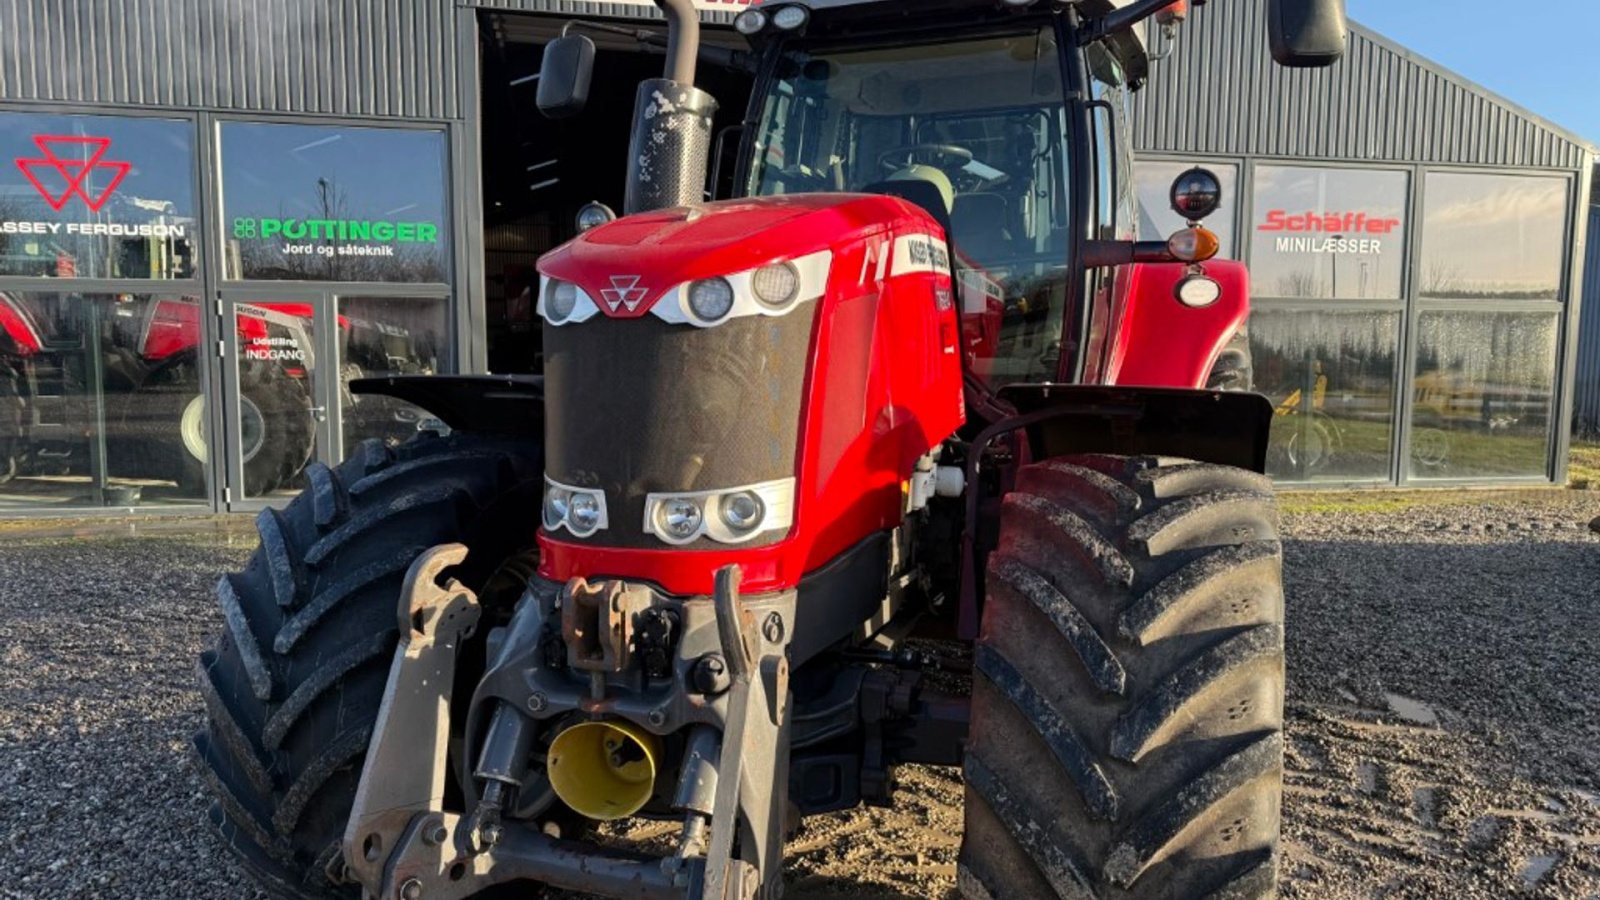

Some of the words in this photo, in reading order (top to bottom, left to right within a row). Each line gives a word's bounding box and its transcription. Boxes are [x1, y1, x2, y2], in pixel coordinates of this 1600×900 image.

[1257, 209, 1399, 233] Schäffer
[0, 222, 61, 234] SSEY
[67, 224, 184, 236] FERGUSON
[282, 243, 313, 254] Jord
[317, 246, 334, 257] og
[338, 243, 394, 256] såteknik
[1276, 237, 1381, 254] MINILÆSSER
[253, 337, 297, 348] Udstilling
[246, 349, 305, 360] INDGANG
